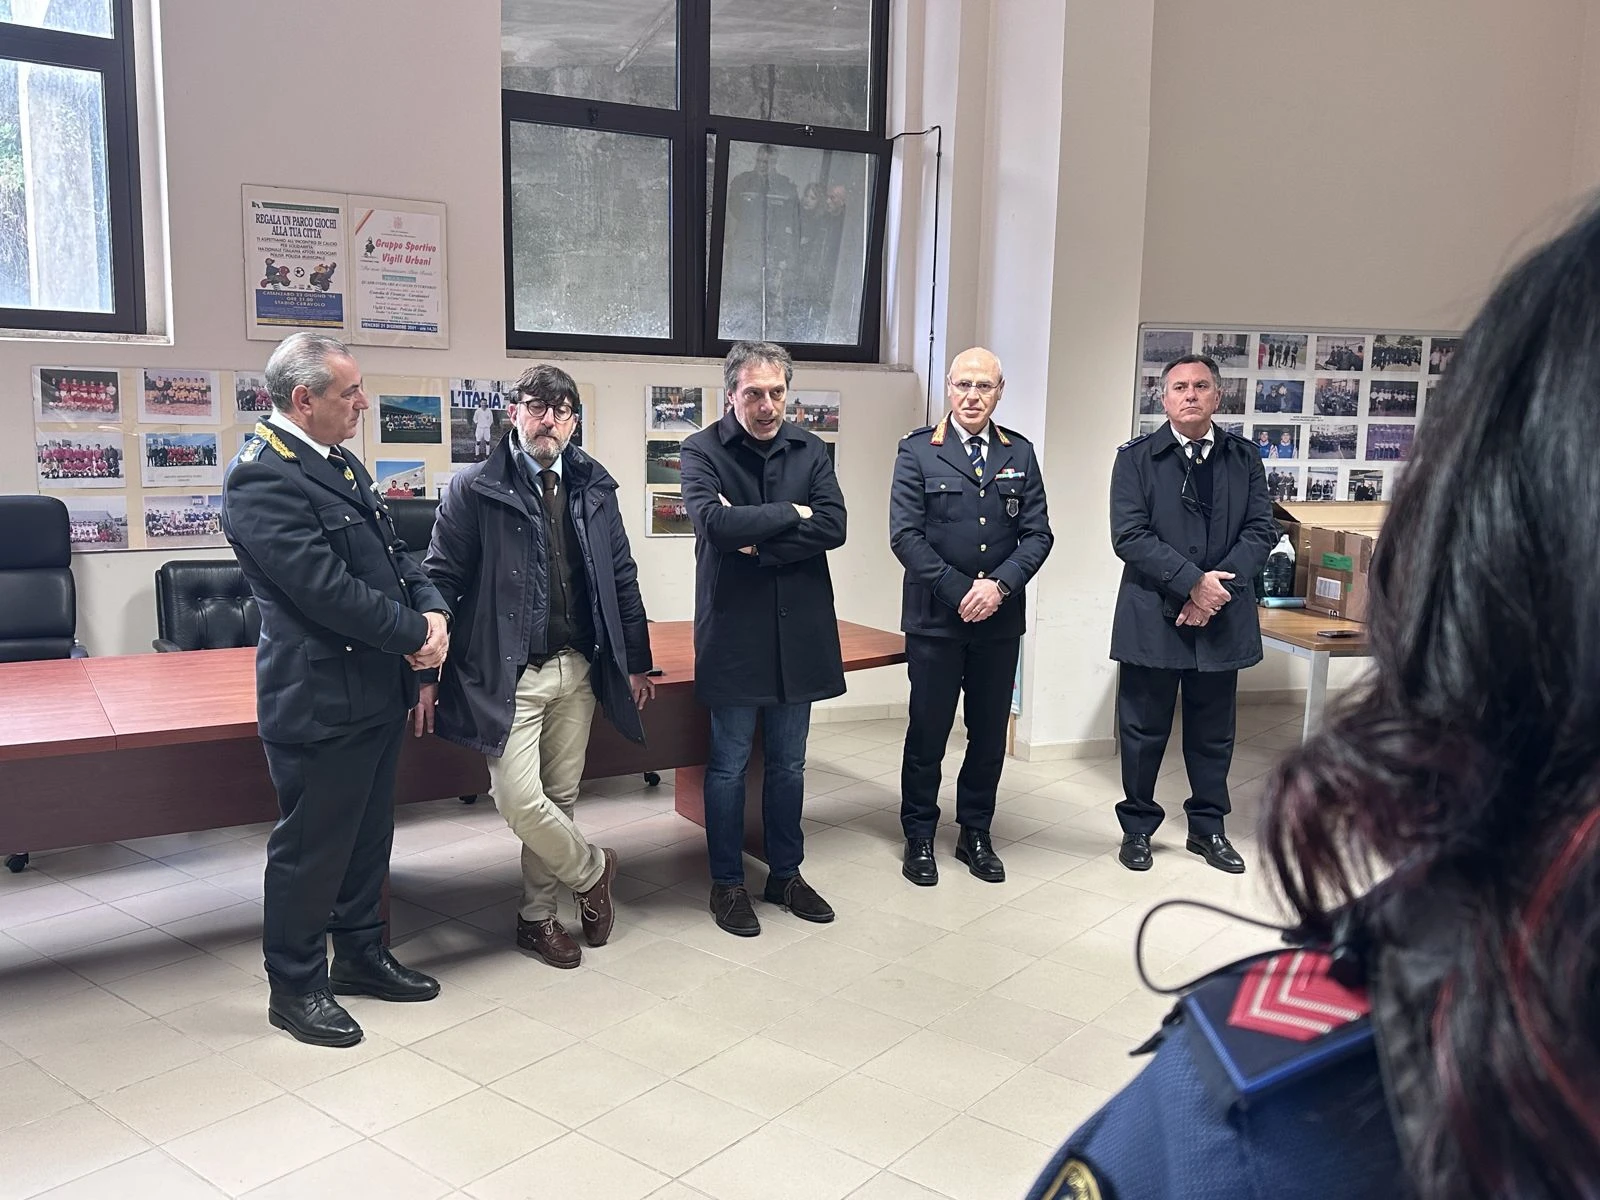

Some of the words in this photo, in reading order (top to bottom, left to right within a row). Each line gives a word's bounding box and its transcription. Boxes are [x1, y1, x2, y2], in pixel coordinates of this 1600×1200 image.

[256, 214, 281, 225] REGALA
[282, 215, 292, 226] UN
[292, 216, 313, 228] PARCO
[314, 218, 336, 229] GIOCHI
[272, 226, 288, 236] ALLA
[289, 227, 302, 238] TUA
[375, 238, 403, 251] Gruppo
[405, 241, 436, 253] Sportivo
[382, 254, 402, 265] Vigili
[405, 256, 432, 266] Urbani
